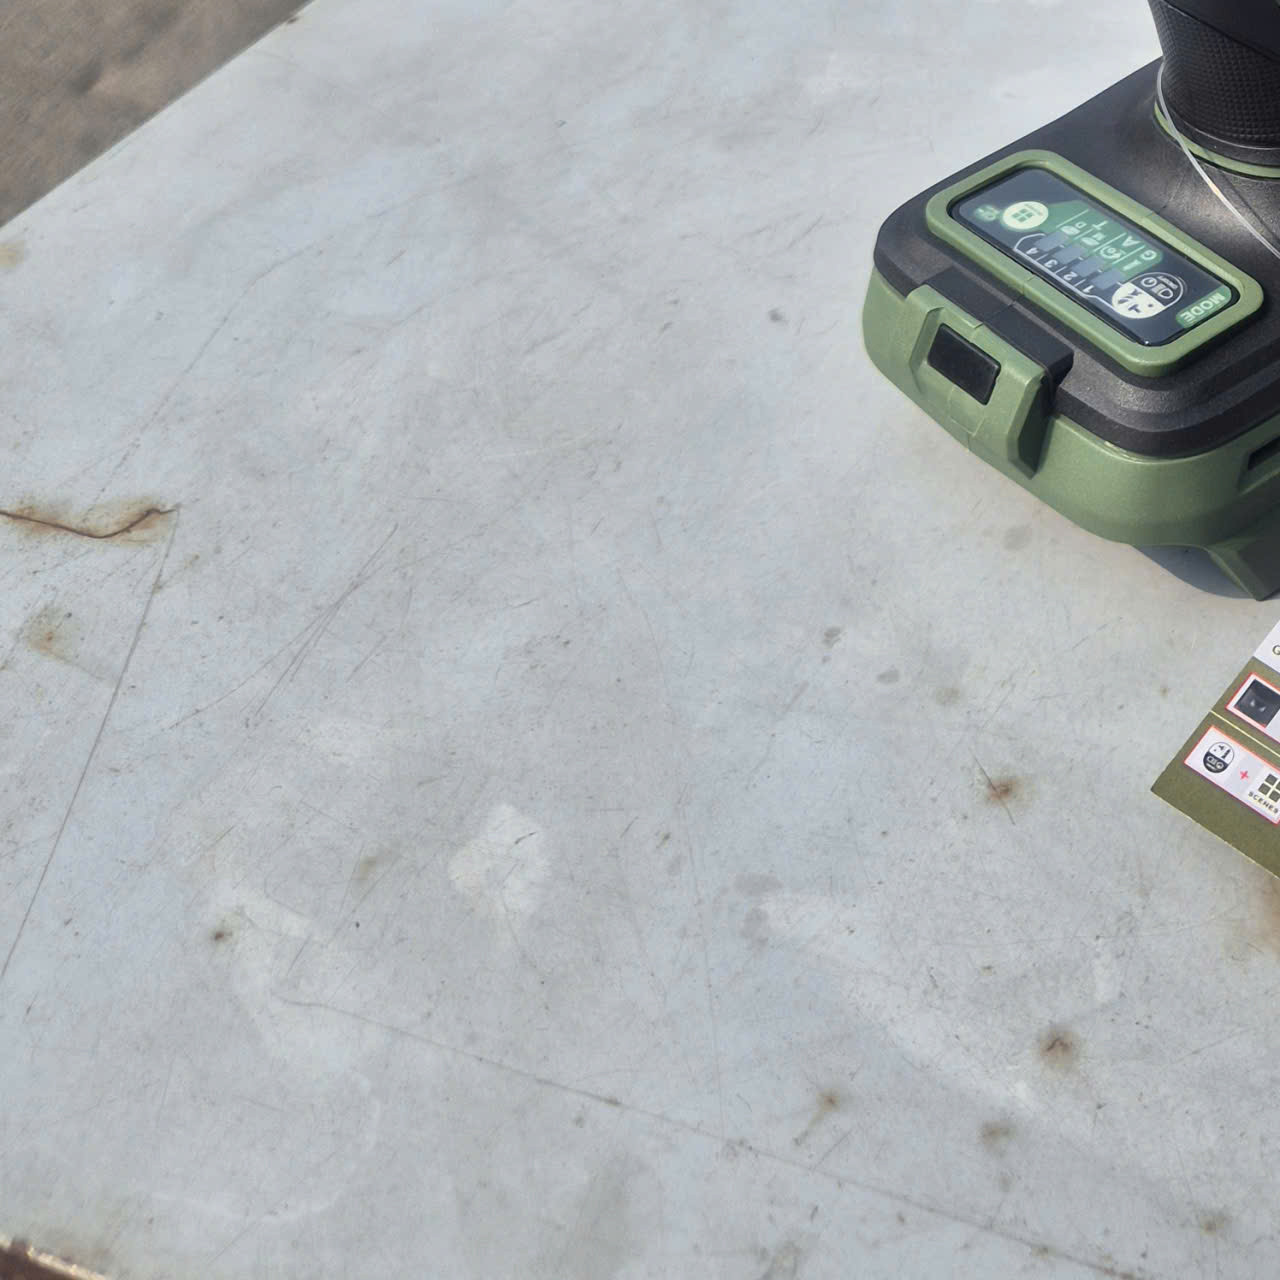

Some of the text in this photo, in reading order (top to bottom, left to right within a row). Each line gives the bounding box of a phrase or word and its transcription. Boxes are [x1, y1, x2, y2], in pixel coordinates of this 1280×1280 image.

[1024, 246, 1095, 293] 1 2 3 4
[1178, 292, 1226, 321] MODE
[1247, 790, 1279, 814] SCENES
